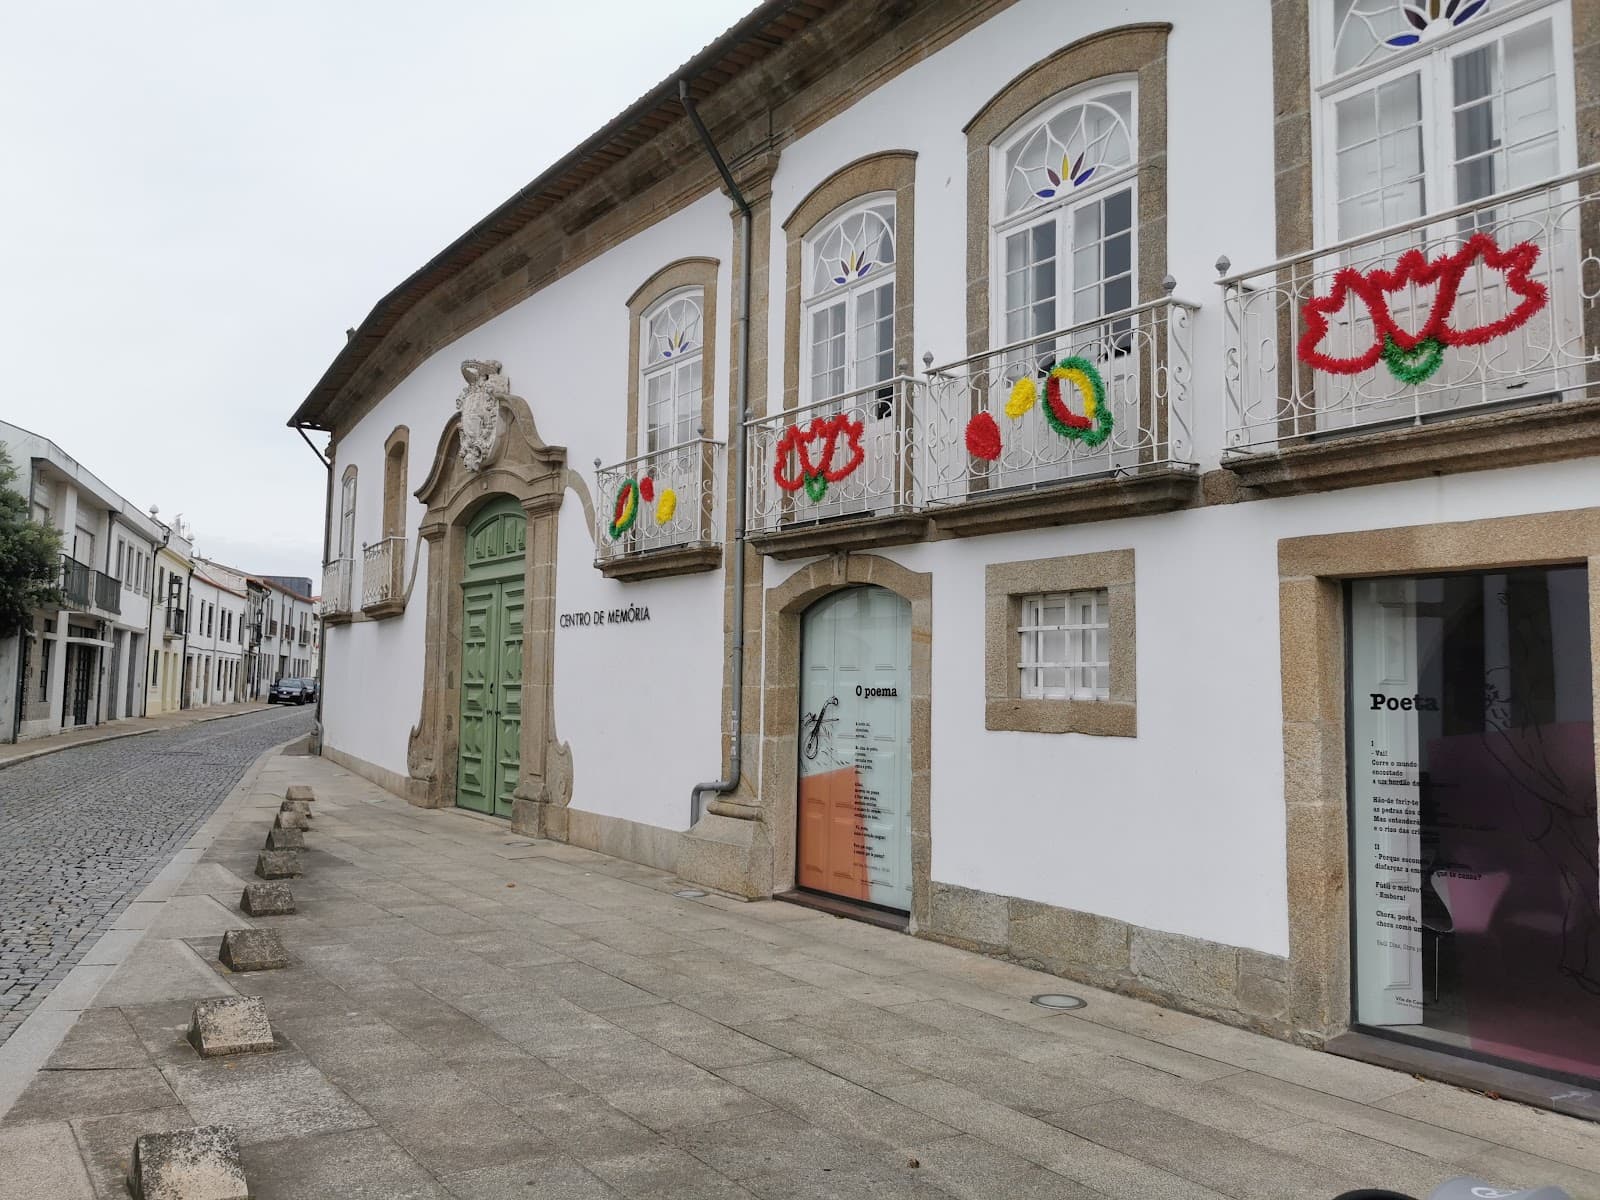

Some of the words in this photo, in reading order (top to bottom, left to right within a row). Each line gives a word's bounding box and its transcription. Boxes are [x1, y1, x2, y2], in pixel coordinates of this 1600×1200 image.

[560, 612, 591, 628] CENTRO
[593, 610, 605, 625] DE
[607, 602, 651, 624] MEMÓRIA
[855, 685, 863, 697] O
[864, 687, 898, 699] poema
[1370, 693, 1440, 711] Poeta
